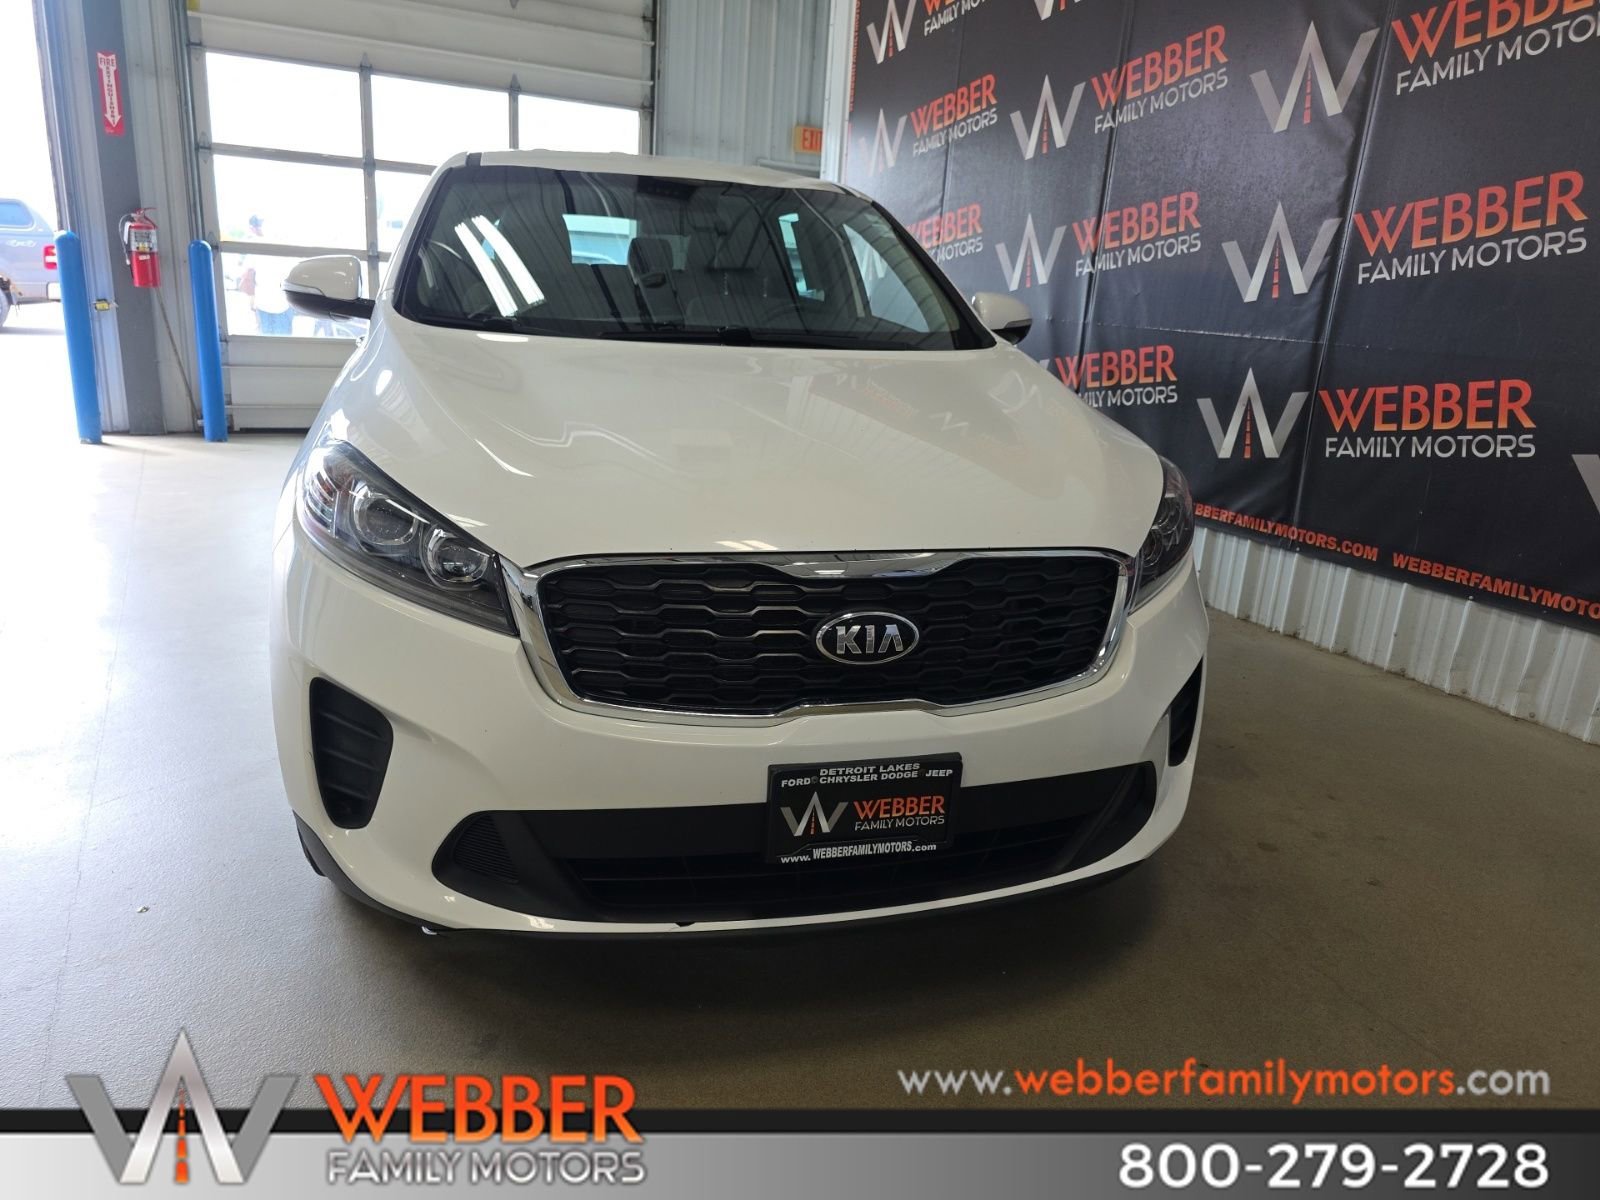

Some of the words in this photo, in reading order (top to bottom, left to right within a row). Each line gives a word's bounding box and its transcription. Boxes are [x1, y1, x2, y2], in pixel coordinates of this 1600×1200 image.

[924, 1, 960, 36] FAMILY
[1090, 24, 1229, 111] WEBBER
[1396, 44, 1492, 95] FAMILY
[1497, 14, 1600, 66] MOTO
[910, 74, 997, 138] WEBBER
[1094, 98, 1148, 134] FAMILY
[1150, 67, 1229, 115] MOTORS
[912, 129, 948, 157] FAMILY
[948, 107, 998, 142] MOTORS
[1072, 191, 1201, 255] WEBBER
[1354, 170, 1589, 257] WEBBER
[1075, 249, 1126, 277] FAMILY
[1127, 232, 1201, 266] MOTORS
[1357, 249, 1447, 285] FAMILY
[1451, 227, 1588, 271] MOTORS
[1055, 345, 1178, 390] WEBBER
[1107, 385, 1178, 407] MOTORS
[1319, 379, 1536, 433] WEBBER
[1325, 435, 1408, 459] FAMILY
[1411, 434, 1536, 459] MOTORS
[1193, 503, 1379, 562] BBERFAMILYMOTORS.COM
[836, 624, 904, 654] KIA
[781, 777, 811, 788] FORD
[819, 773, 878, 784] CHRYSLER
[881, 770, 919, 781] DODGE
[925, 769, 953, 778] JEEP
[819, 765, 876, 776] DETROIT
[879, 763, 920, 773] LAKES
[853, 795, 945, 820] WEBBER
[854, 818, 894, 831] FAMILY
[895, 815, 945, 828] MOTORS
